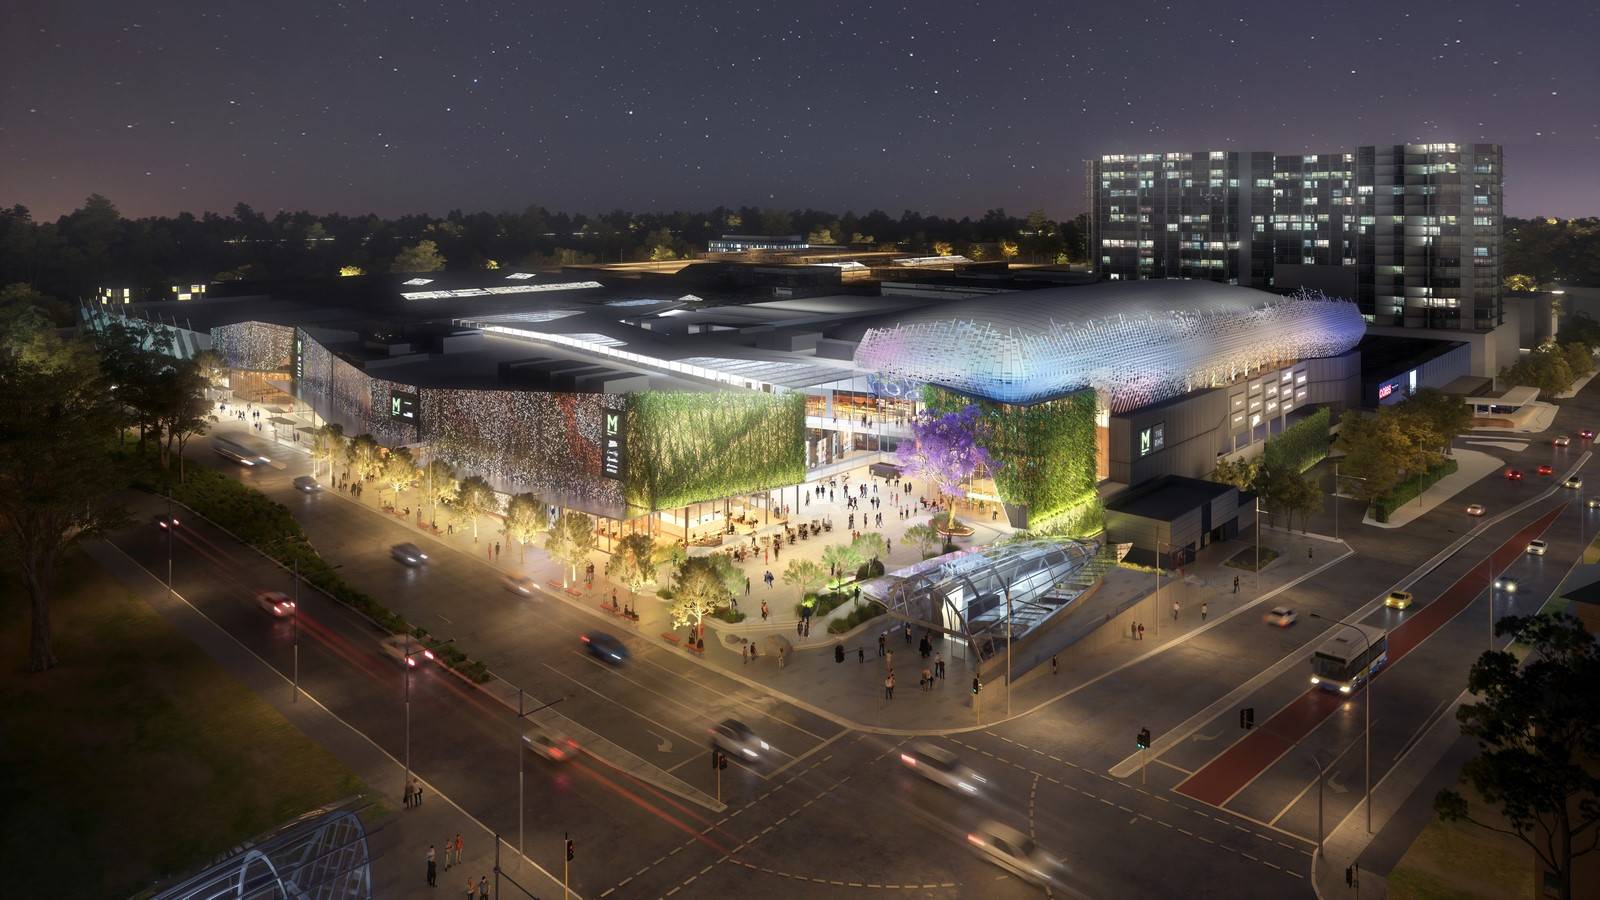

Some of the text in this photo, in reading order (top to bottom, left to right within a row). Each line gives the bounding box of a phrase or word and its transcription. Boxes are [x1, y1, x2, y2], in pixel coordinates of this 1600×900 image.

[392, 397, 401, 412] M
[607, 414, 618, 431] M
[1141, 428, 1151, 449] M
